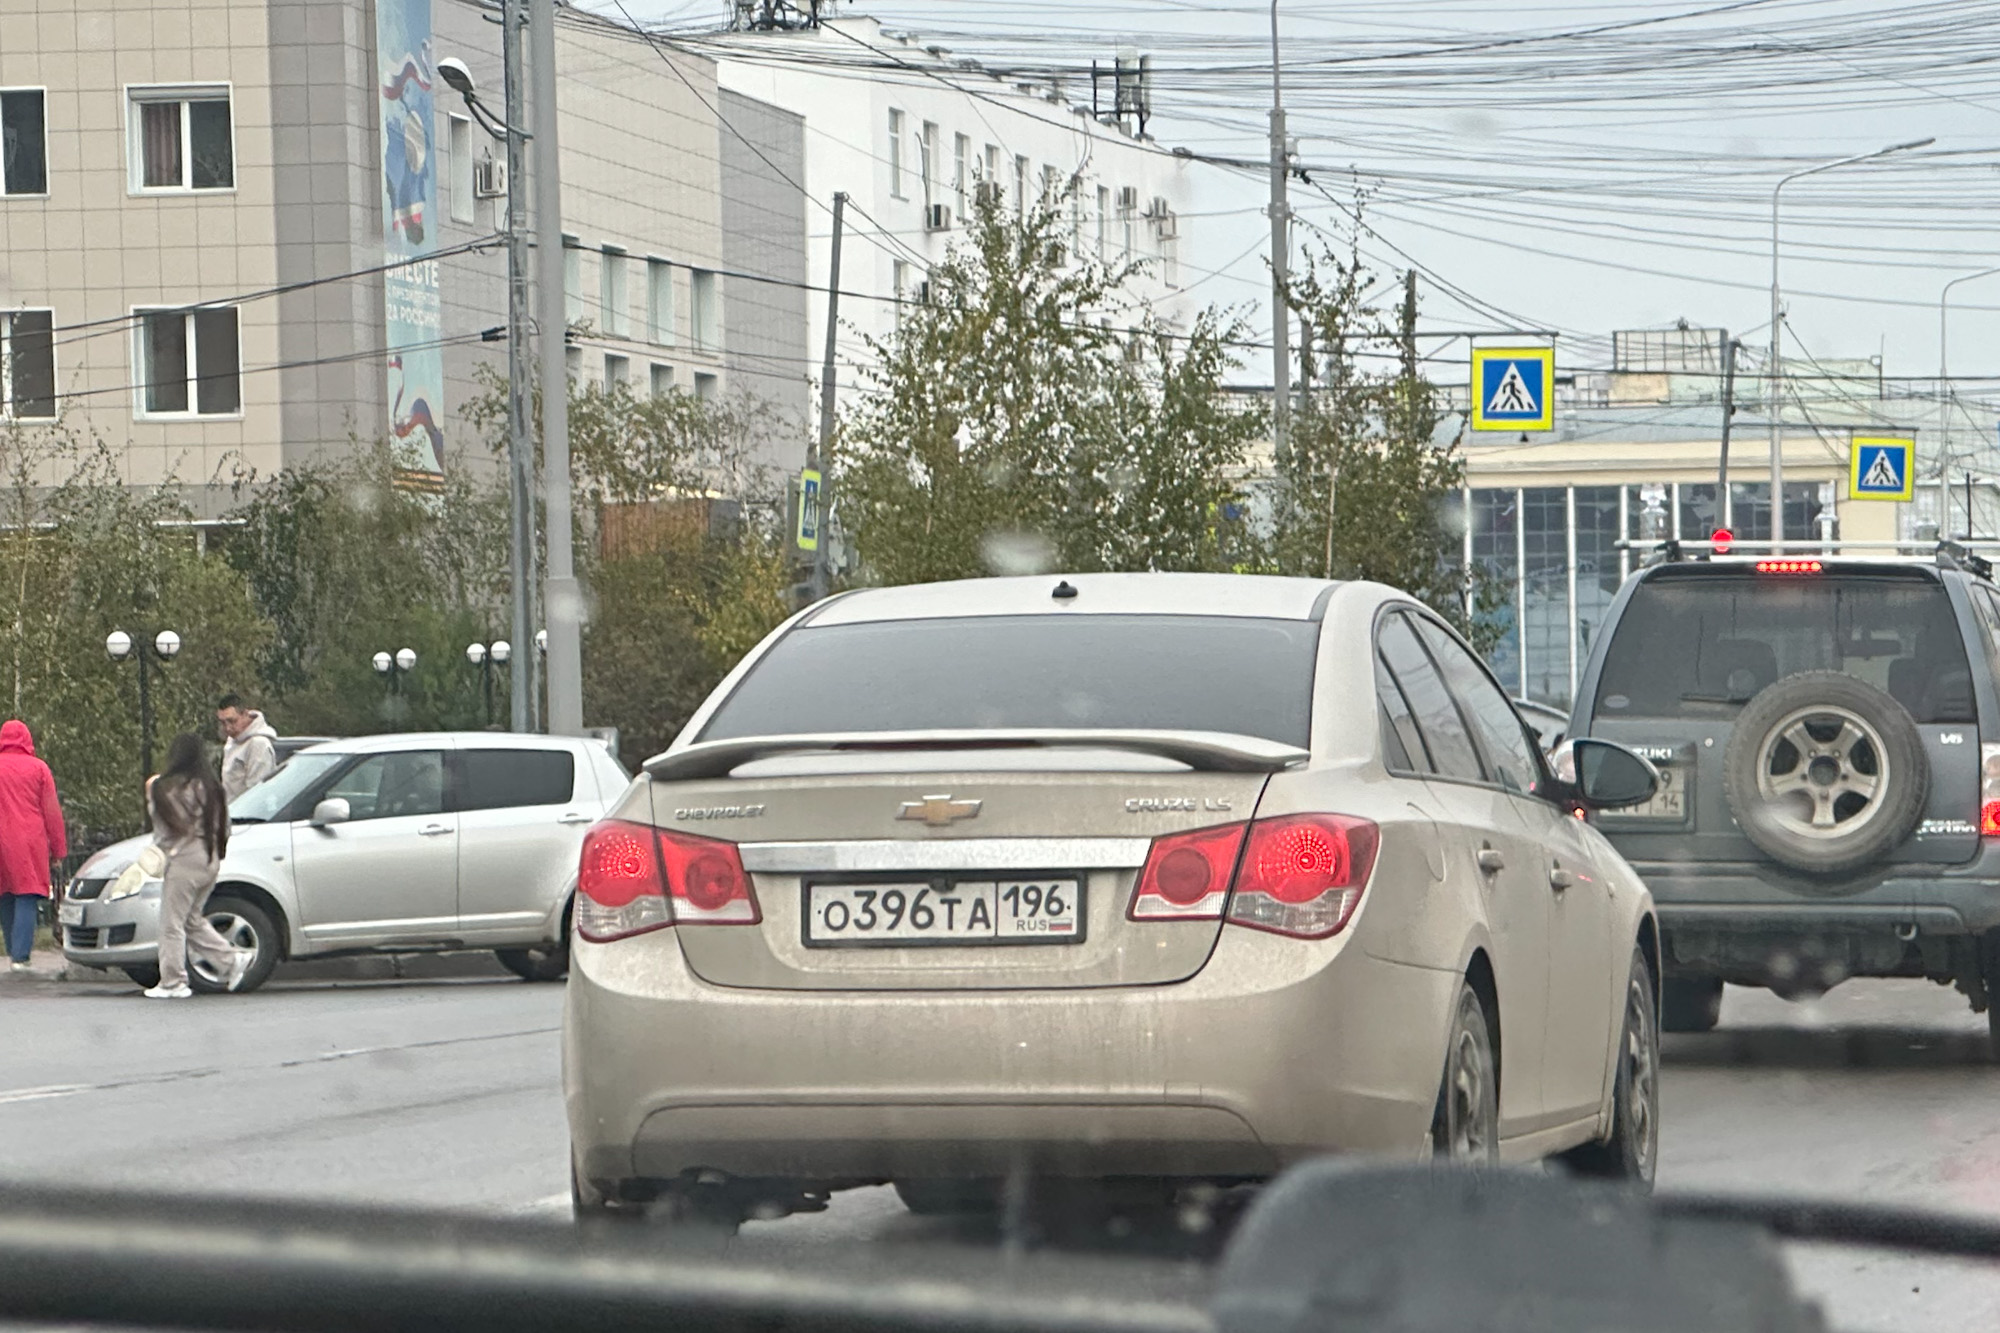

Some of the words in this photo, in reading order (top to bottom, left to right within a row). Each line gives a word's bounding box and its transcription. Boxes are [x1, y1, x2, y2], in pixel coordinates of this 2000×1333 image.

[674, 804, 765, 821] CHEVROLET
[1125, 798, 1197, 813] CRUZE
[1204, 798, 1232, 812] LS
[1002, 884, 1065, 919] 196
[1016, 920, 1048, 932] RUS
